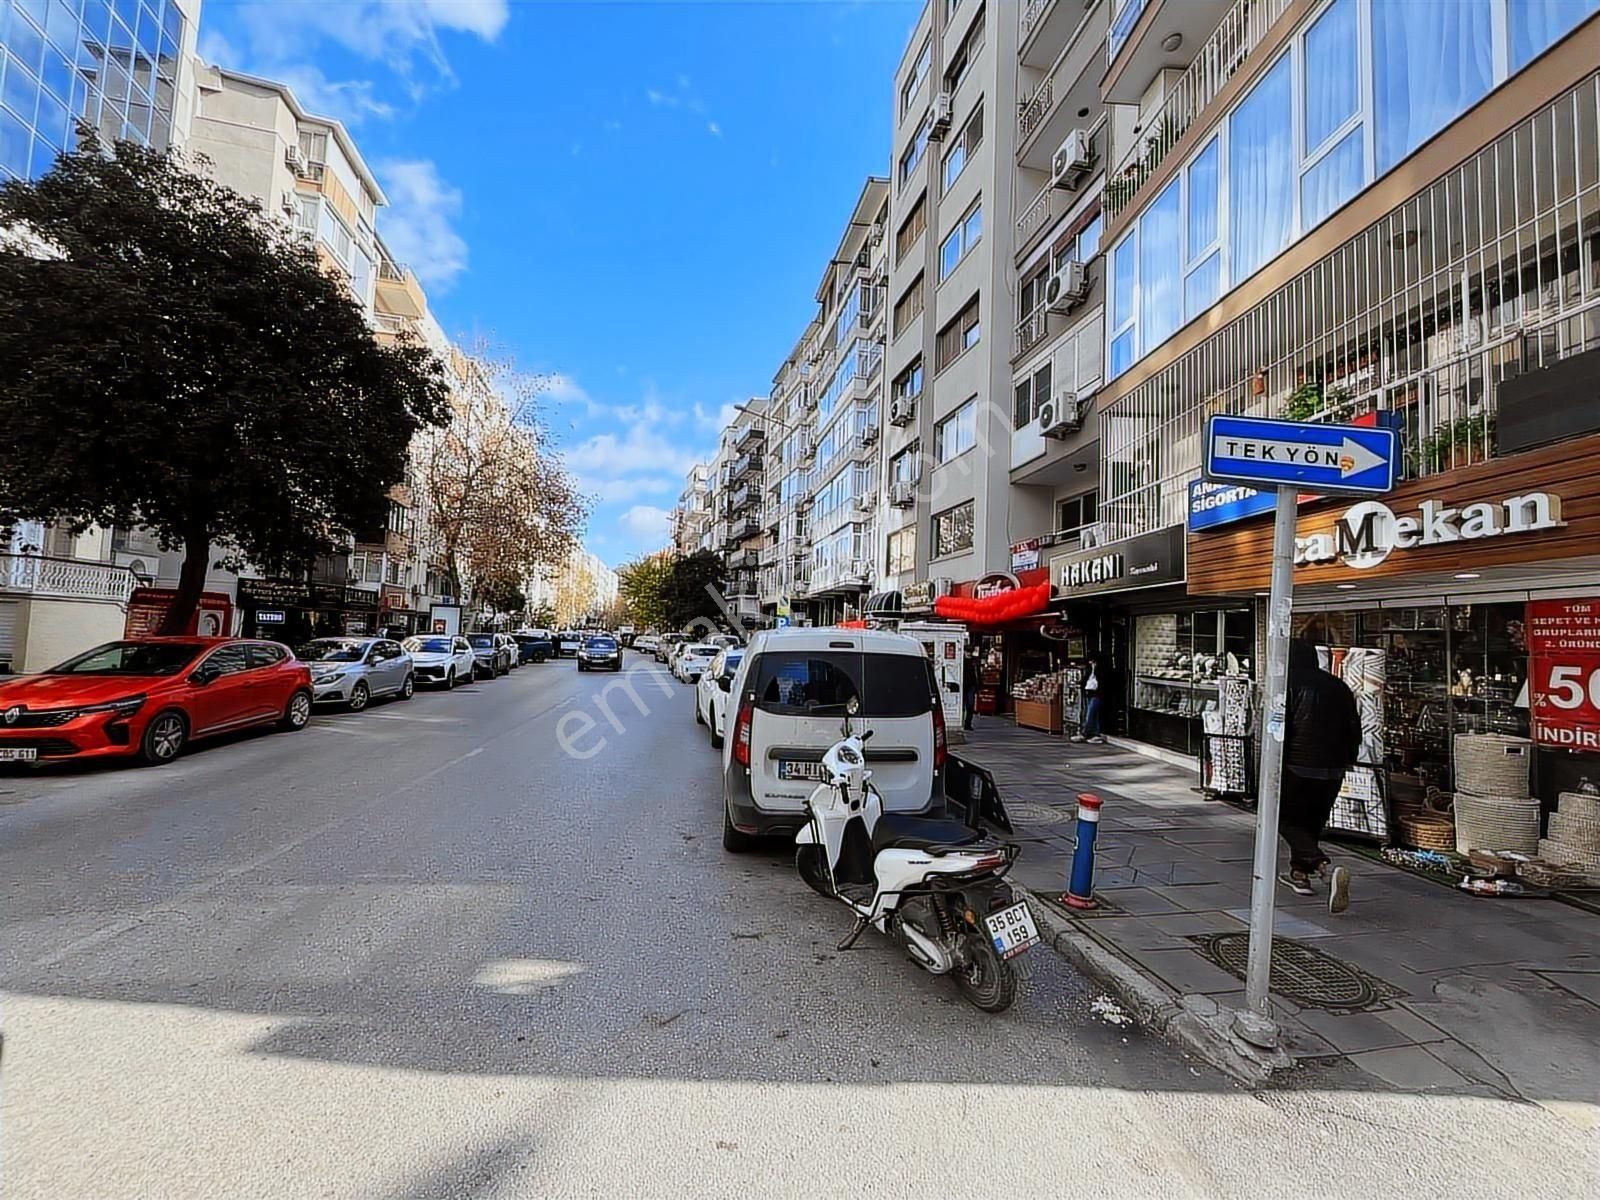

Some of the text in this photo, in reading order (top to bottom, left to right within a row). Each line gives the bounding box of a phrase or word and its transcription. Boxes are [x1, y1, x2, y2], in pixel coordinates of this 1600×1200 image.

[1226, 441, 1339, 466] TEK YÖN
[786, 763, 801, 775] 34
[989, 904, 1027, 933] 35 BCT
[1007, 924, 1029, 945] 159
